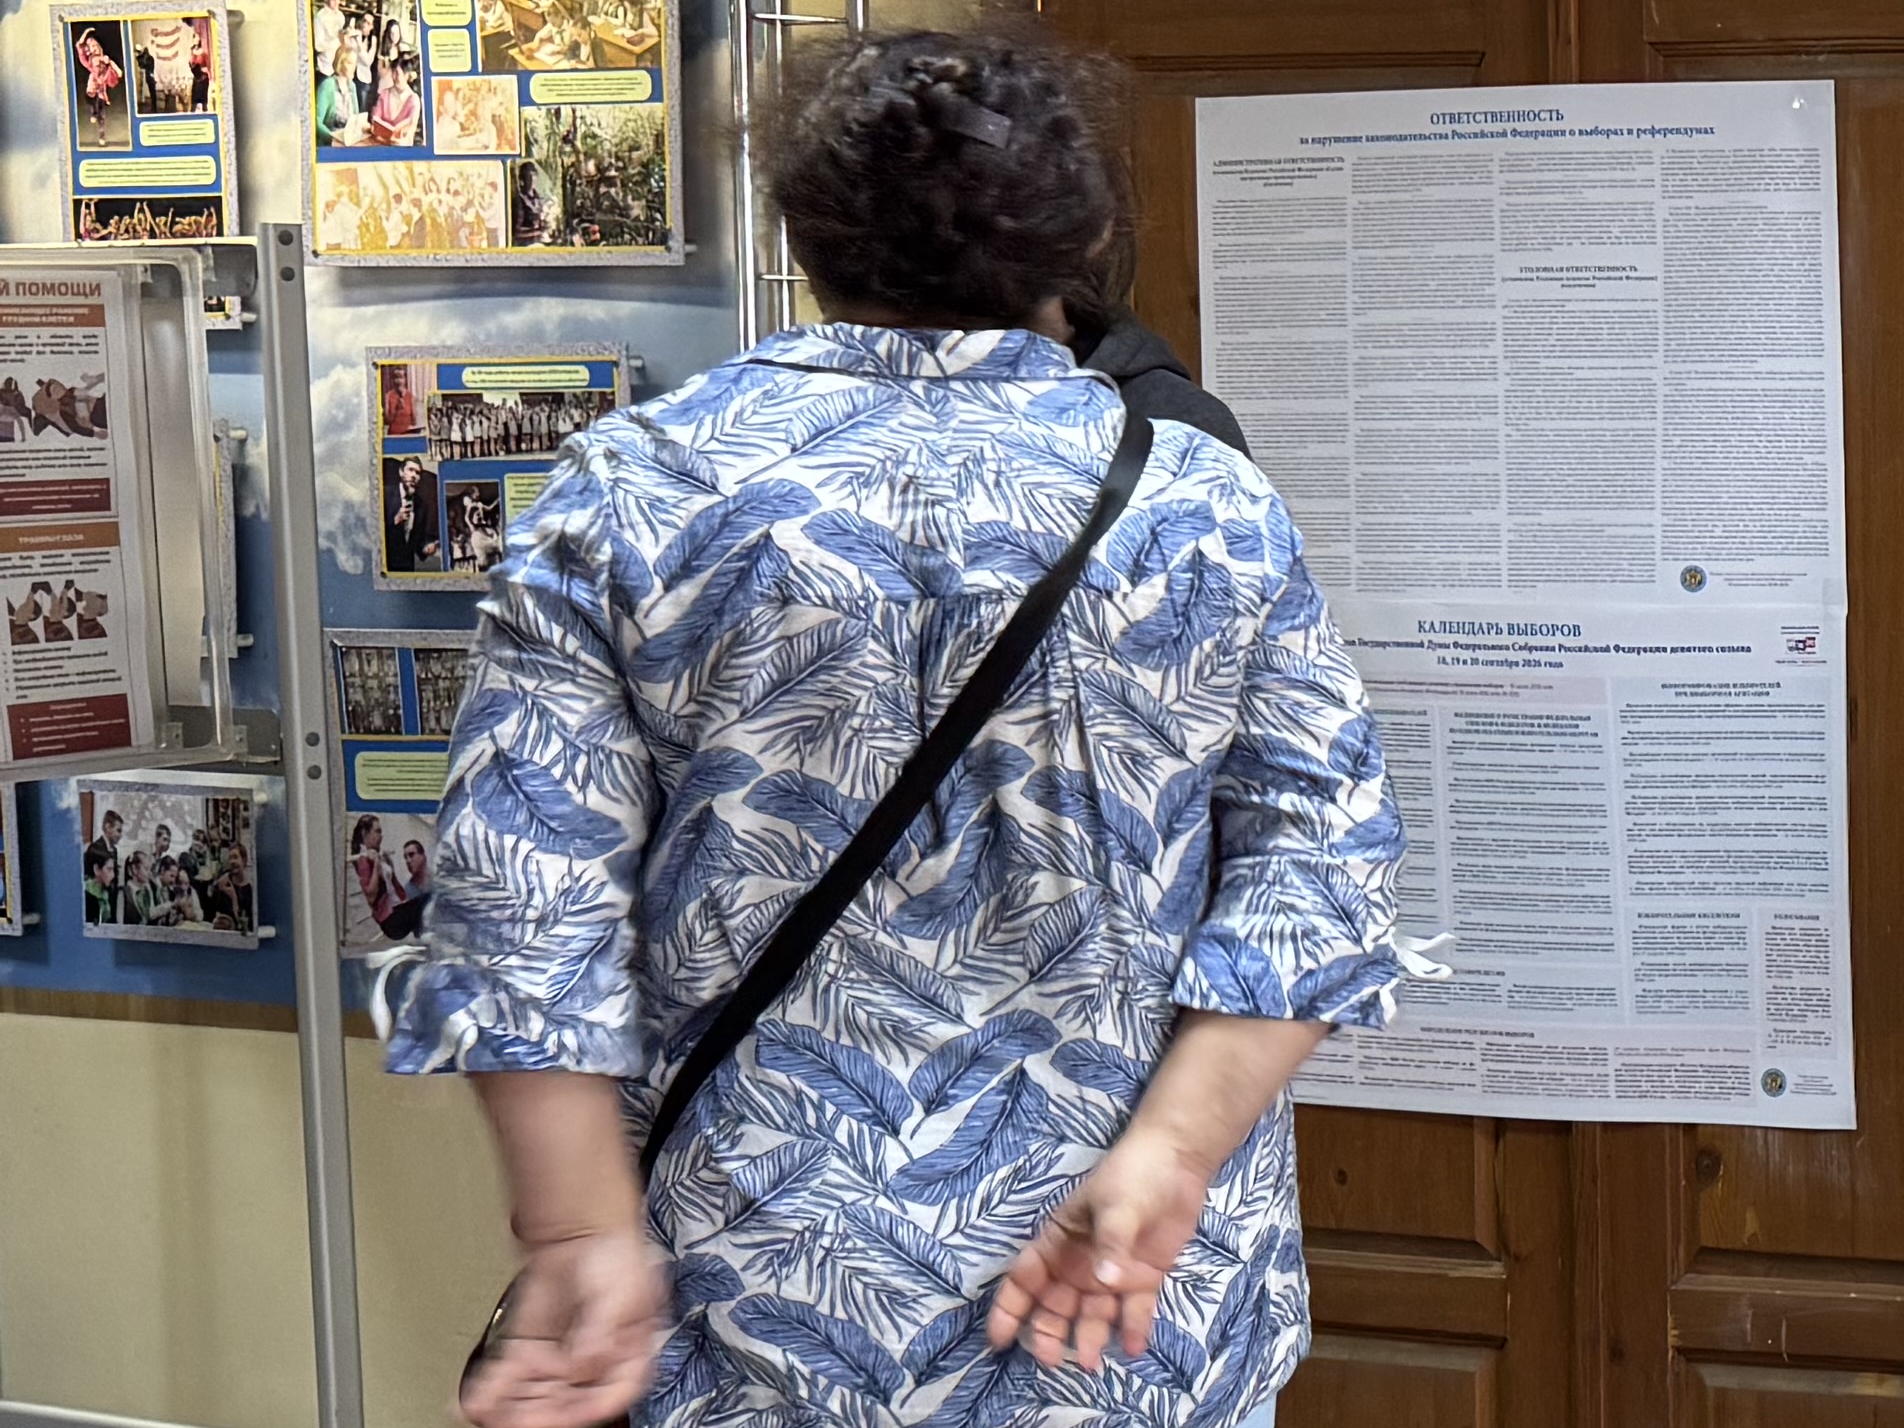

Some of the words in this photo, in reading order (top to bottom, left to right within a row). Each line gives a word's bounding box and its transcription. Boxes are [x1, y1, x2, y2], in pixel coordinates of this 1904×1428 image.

[1430, 109, 1564, 125] ОТВЕТСТВЕННОСТЬ
[1450, 128, 1508, 141] Российской
[15, 282, 102, 299] ПОМОЩИ
[1417, 620, 1503, 638] КАЛЕНДАРЬ
[1506, 622, 1582, 638] ВЫБОРОВ
